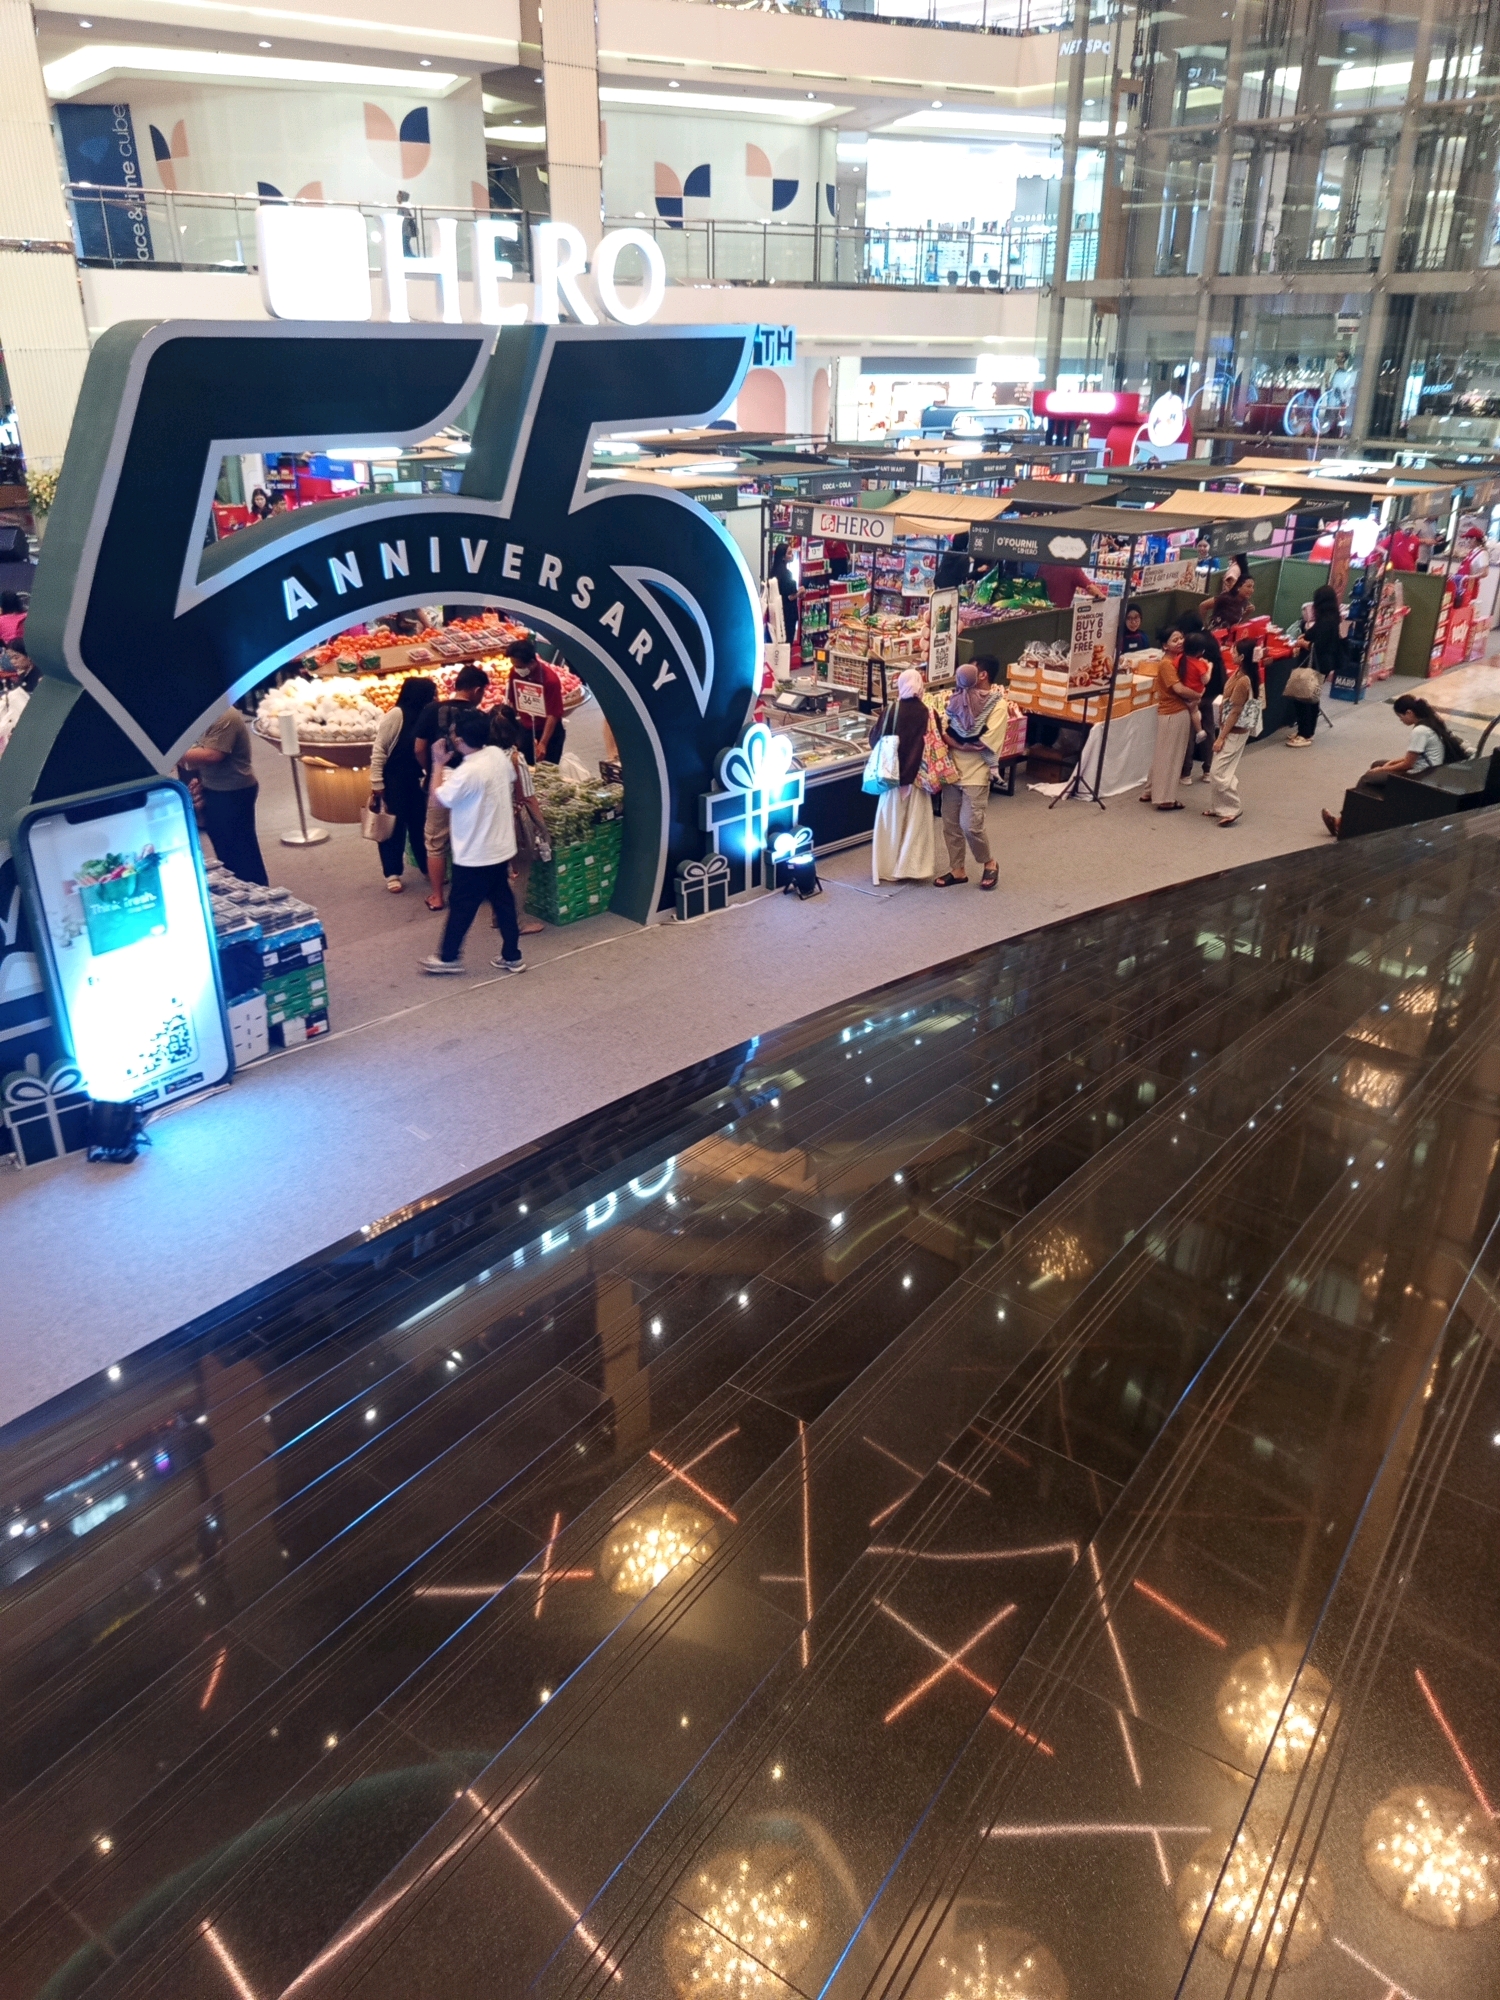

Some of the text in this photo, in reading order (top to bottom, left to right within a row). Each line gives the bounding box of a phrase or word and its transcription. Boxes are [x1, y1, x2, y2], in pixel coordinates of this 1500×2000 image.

[113, 104, 133, 157] cube
[378, 212, 667, 326] HERO
[839, 481, 852, 489] COLA
[836, 515, 885, 538] HERO
[996, 536, 1038, 549] O'FOURNIL
[282, 536, 677, 692] ANNIVERSARY
[1076, 618, 1103, 631] BUY 6
[1075, 629, 1102, 642] GET 6
[1074, 641, 1094, 652] FREE
